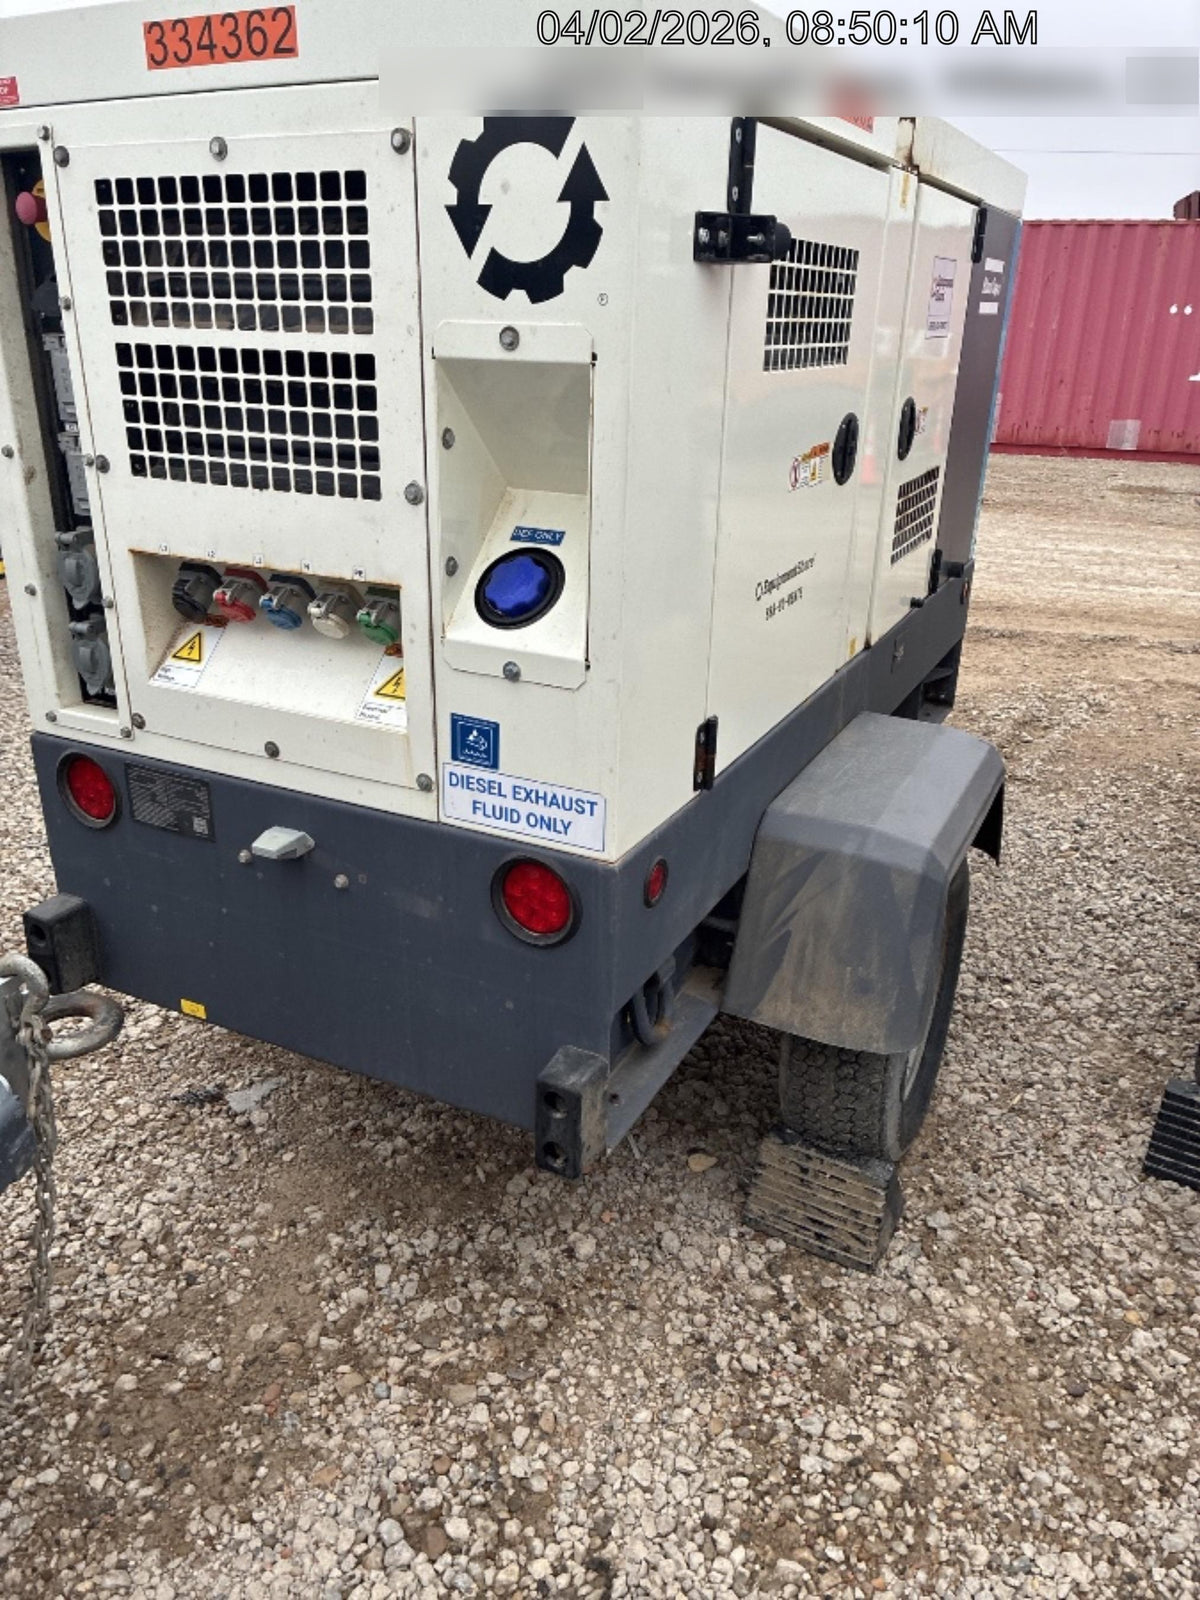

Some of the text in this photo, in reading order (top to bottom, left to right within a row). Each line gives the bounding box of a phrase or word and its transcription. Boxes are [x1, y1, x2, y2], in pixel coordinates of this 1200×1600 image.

[147, 6, 296, 66] 334362
[448, 771, 598, 817] DIESEL EXHAUST
[472, 799, 572, 836] FLUID ONLY
